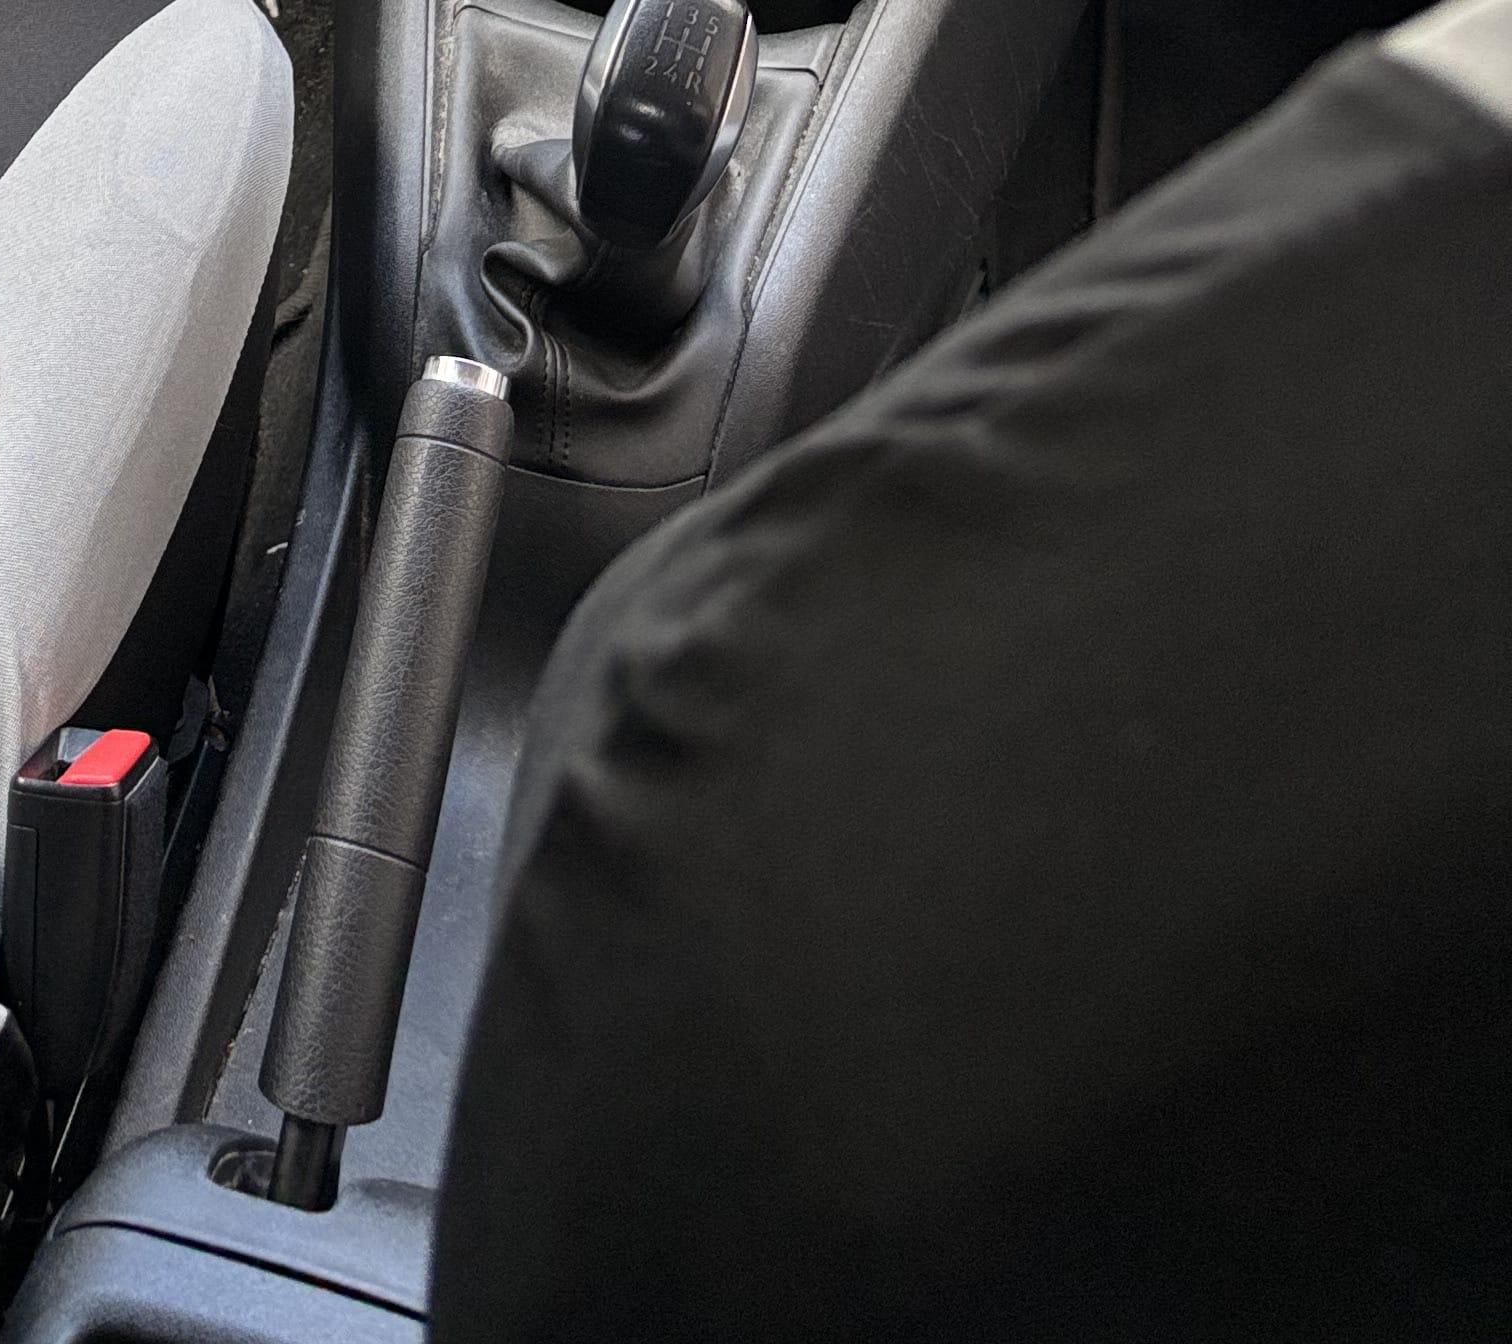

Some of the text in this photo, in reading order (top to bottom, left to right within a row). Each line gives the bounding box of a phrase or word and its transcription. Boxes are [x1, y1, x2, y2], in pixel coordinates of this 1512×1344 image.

[665, 0, 719, 35] 1 3 5
[645, 56, 702, 95] 2 4 R
